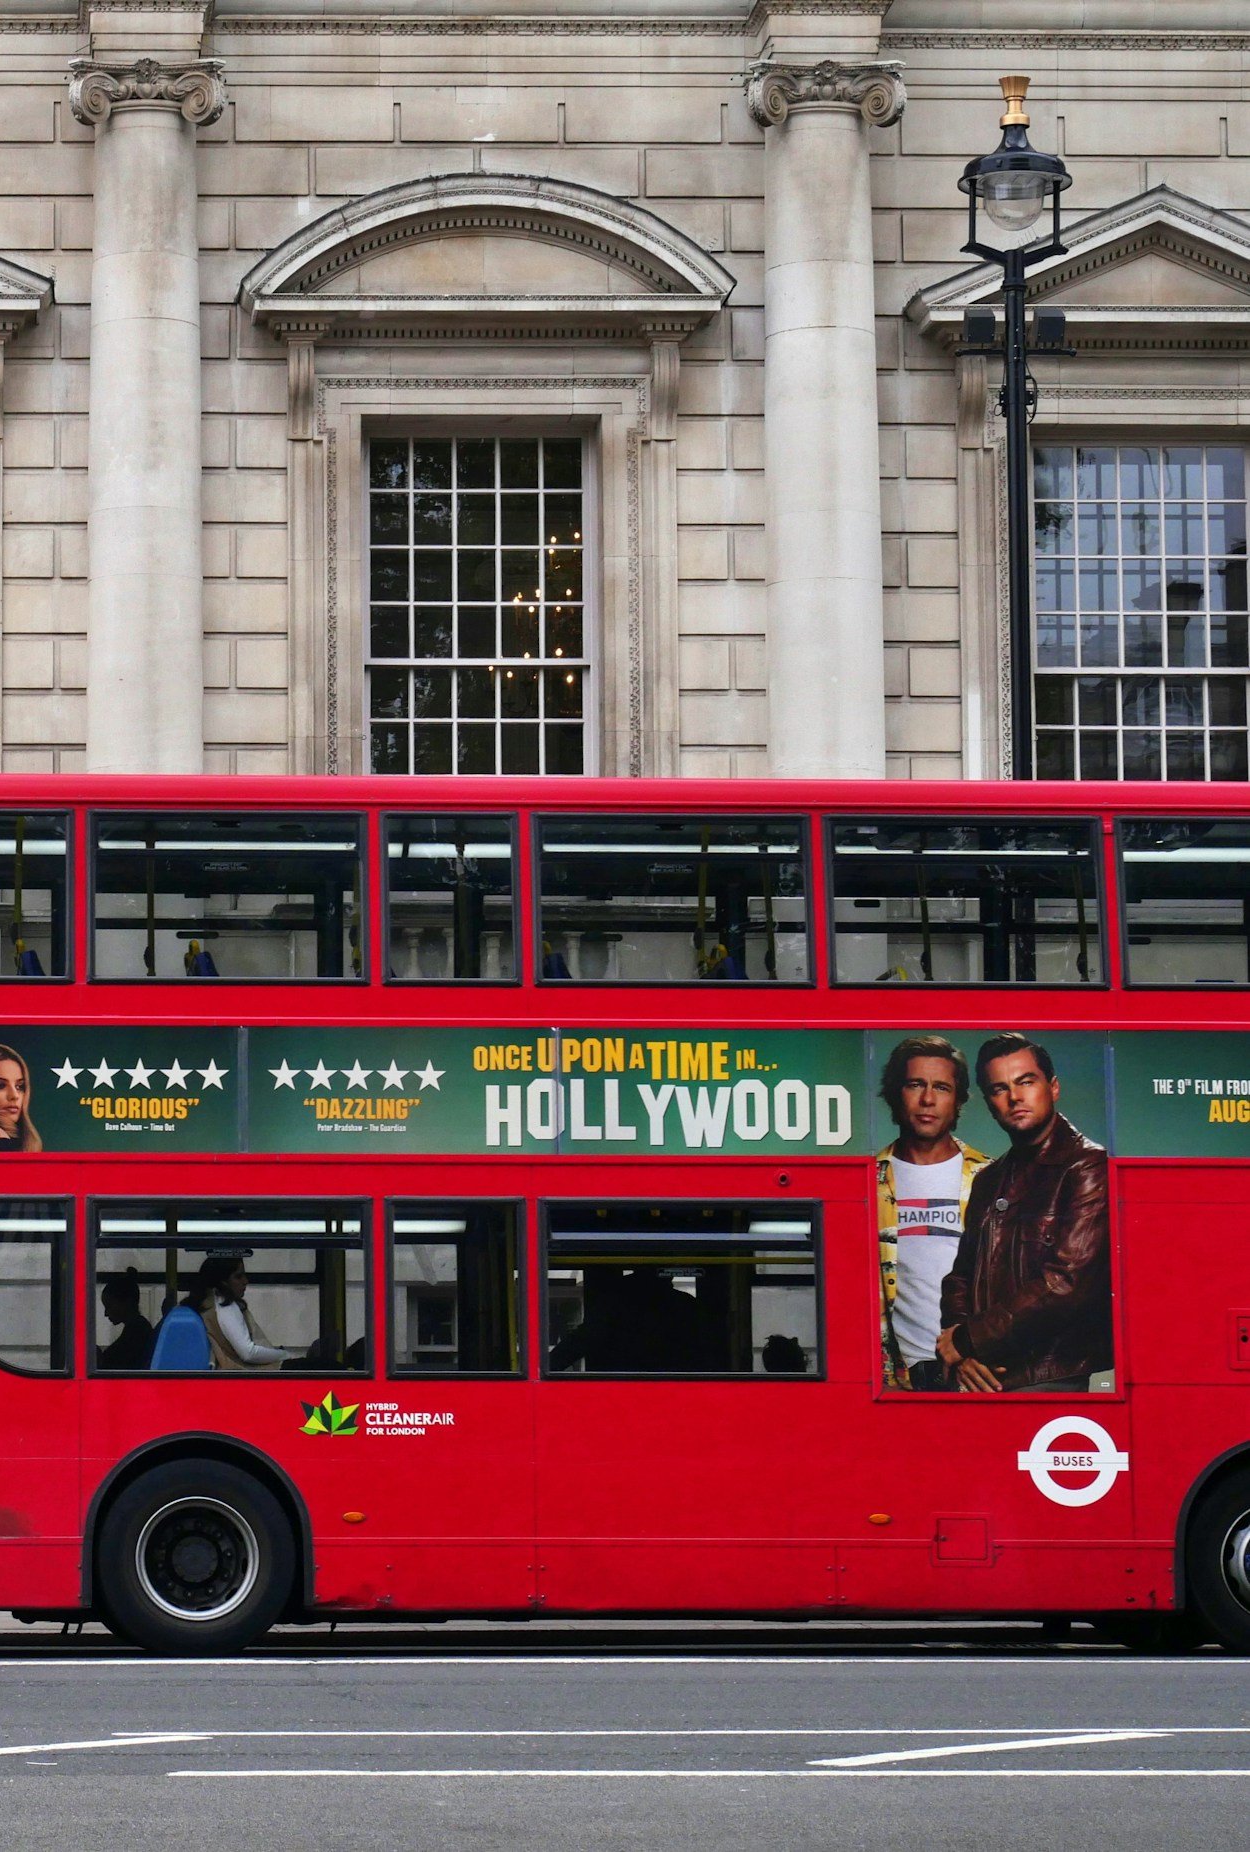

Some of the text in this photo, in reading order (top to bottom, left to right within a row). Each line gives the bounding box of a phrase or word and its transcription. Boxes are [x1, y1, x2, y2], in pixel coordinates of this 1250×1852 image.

[473, 1037, 778, 1081] ONCE UPON A TIME IN...
[1153, 1079, 1174, 1095] THE
[1226, 1079, 1250, 1095] FRO
[79, 1097, 200, 1119] “GLORIOUS”
[303, 1098, 421, 1120] “DAZZLING”
[485, 1078, 852, 1148] HOLLYWOOD
[150, 1123, 164, 1131] Time
[366, 1403, 398, 1411] HYBRID
[365, 1412, 455, 1426] CLEANERAIR
[366, 1427, 426, 1436] FOR LONDON
[1053, 1456, 1093, 1467] BUSES
